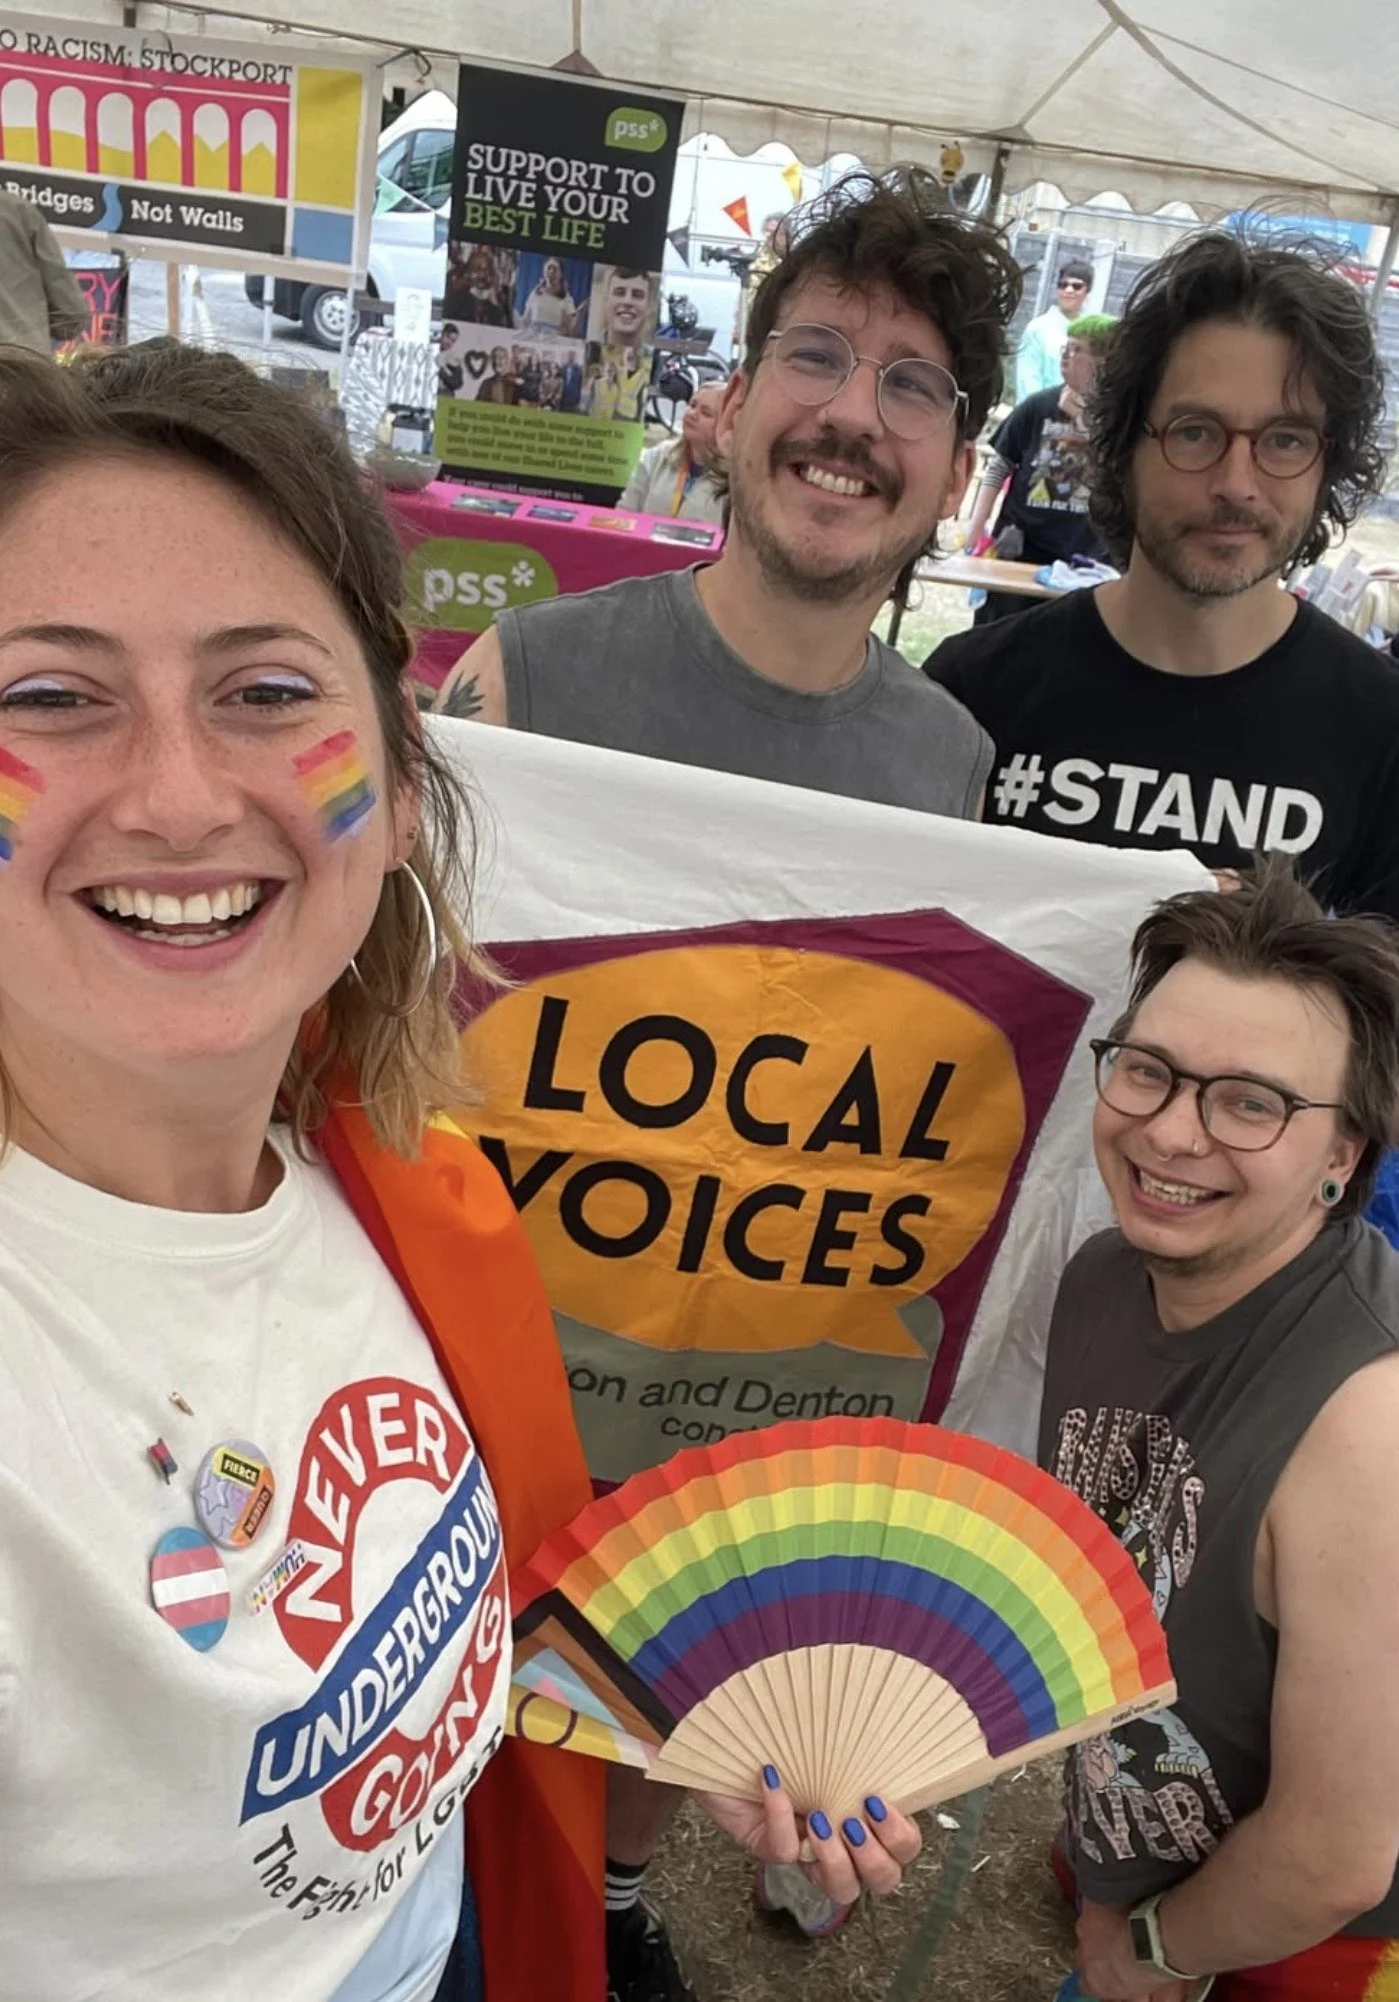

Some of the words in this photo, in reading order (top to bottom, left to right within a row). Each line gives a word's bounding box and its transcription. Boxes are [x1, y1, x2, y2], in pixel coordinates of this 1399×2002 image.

[141, 49, 293, 85] STOCKPORT
[465, 172, 537, 208] LIVE
[543, 185, 630, 224] YOUR
[467, 143, 608, 190] SUPPORT
[615, 167, 655, 198] TO
[6, 181, 95, 214] Bridges
[131, 200, 173, 224] Not
[180, 207, 244, 232] Walls
[463, 202, 537, 237] BEST
[543, 214, 606, 249] LIFE
[994, 753, 1324, 854] #STAND
[523, 995, 956, 1161] LOCAL
[480, 1135, 933, 1287] VOICES
[566, 1365, 627, 1403] on
[638, 1376, 729, 1408] and
[734, 1379, 895, 1418] Denton
[224, 1459, 258, 1482] FIERCE
[285, 1392, 451, 1622] NEVER
[350, 1594, 501, 1837] GOING
[253, 1823, 298, 1898] The
[373, 1846, 406, 1901] for
